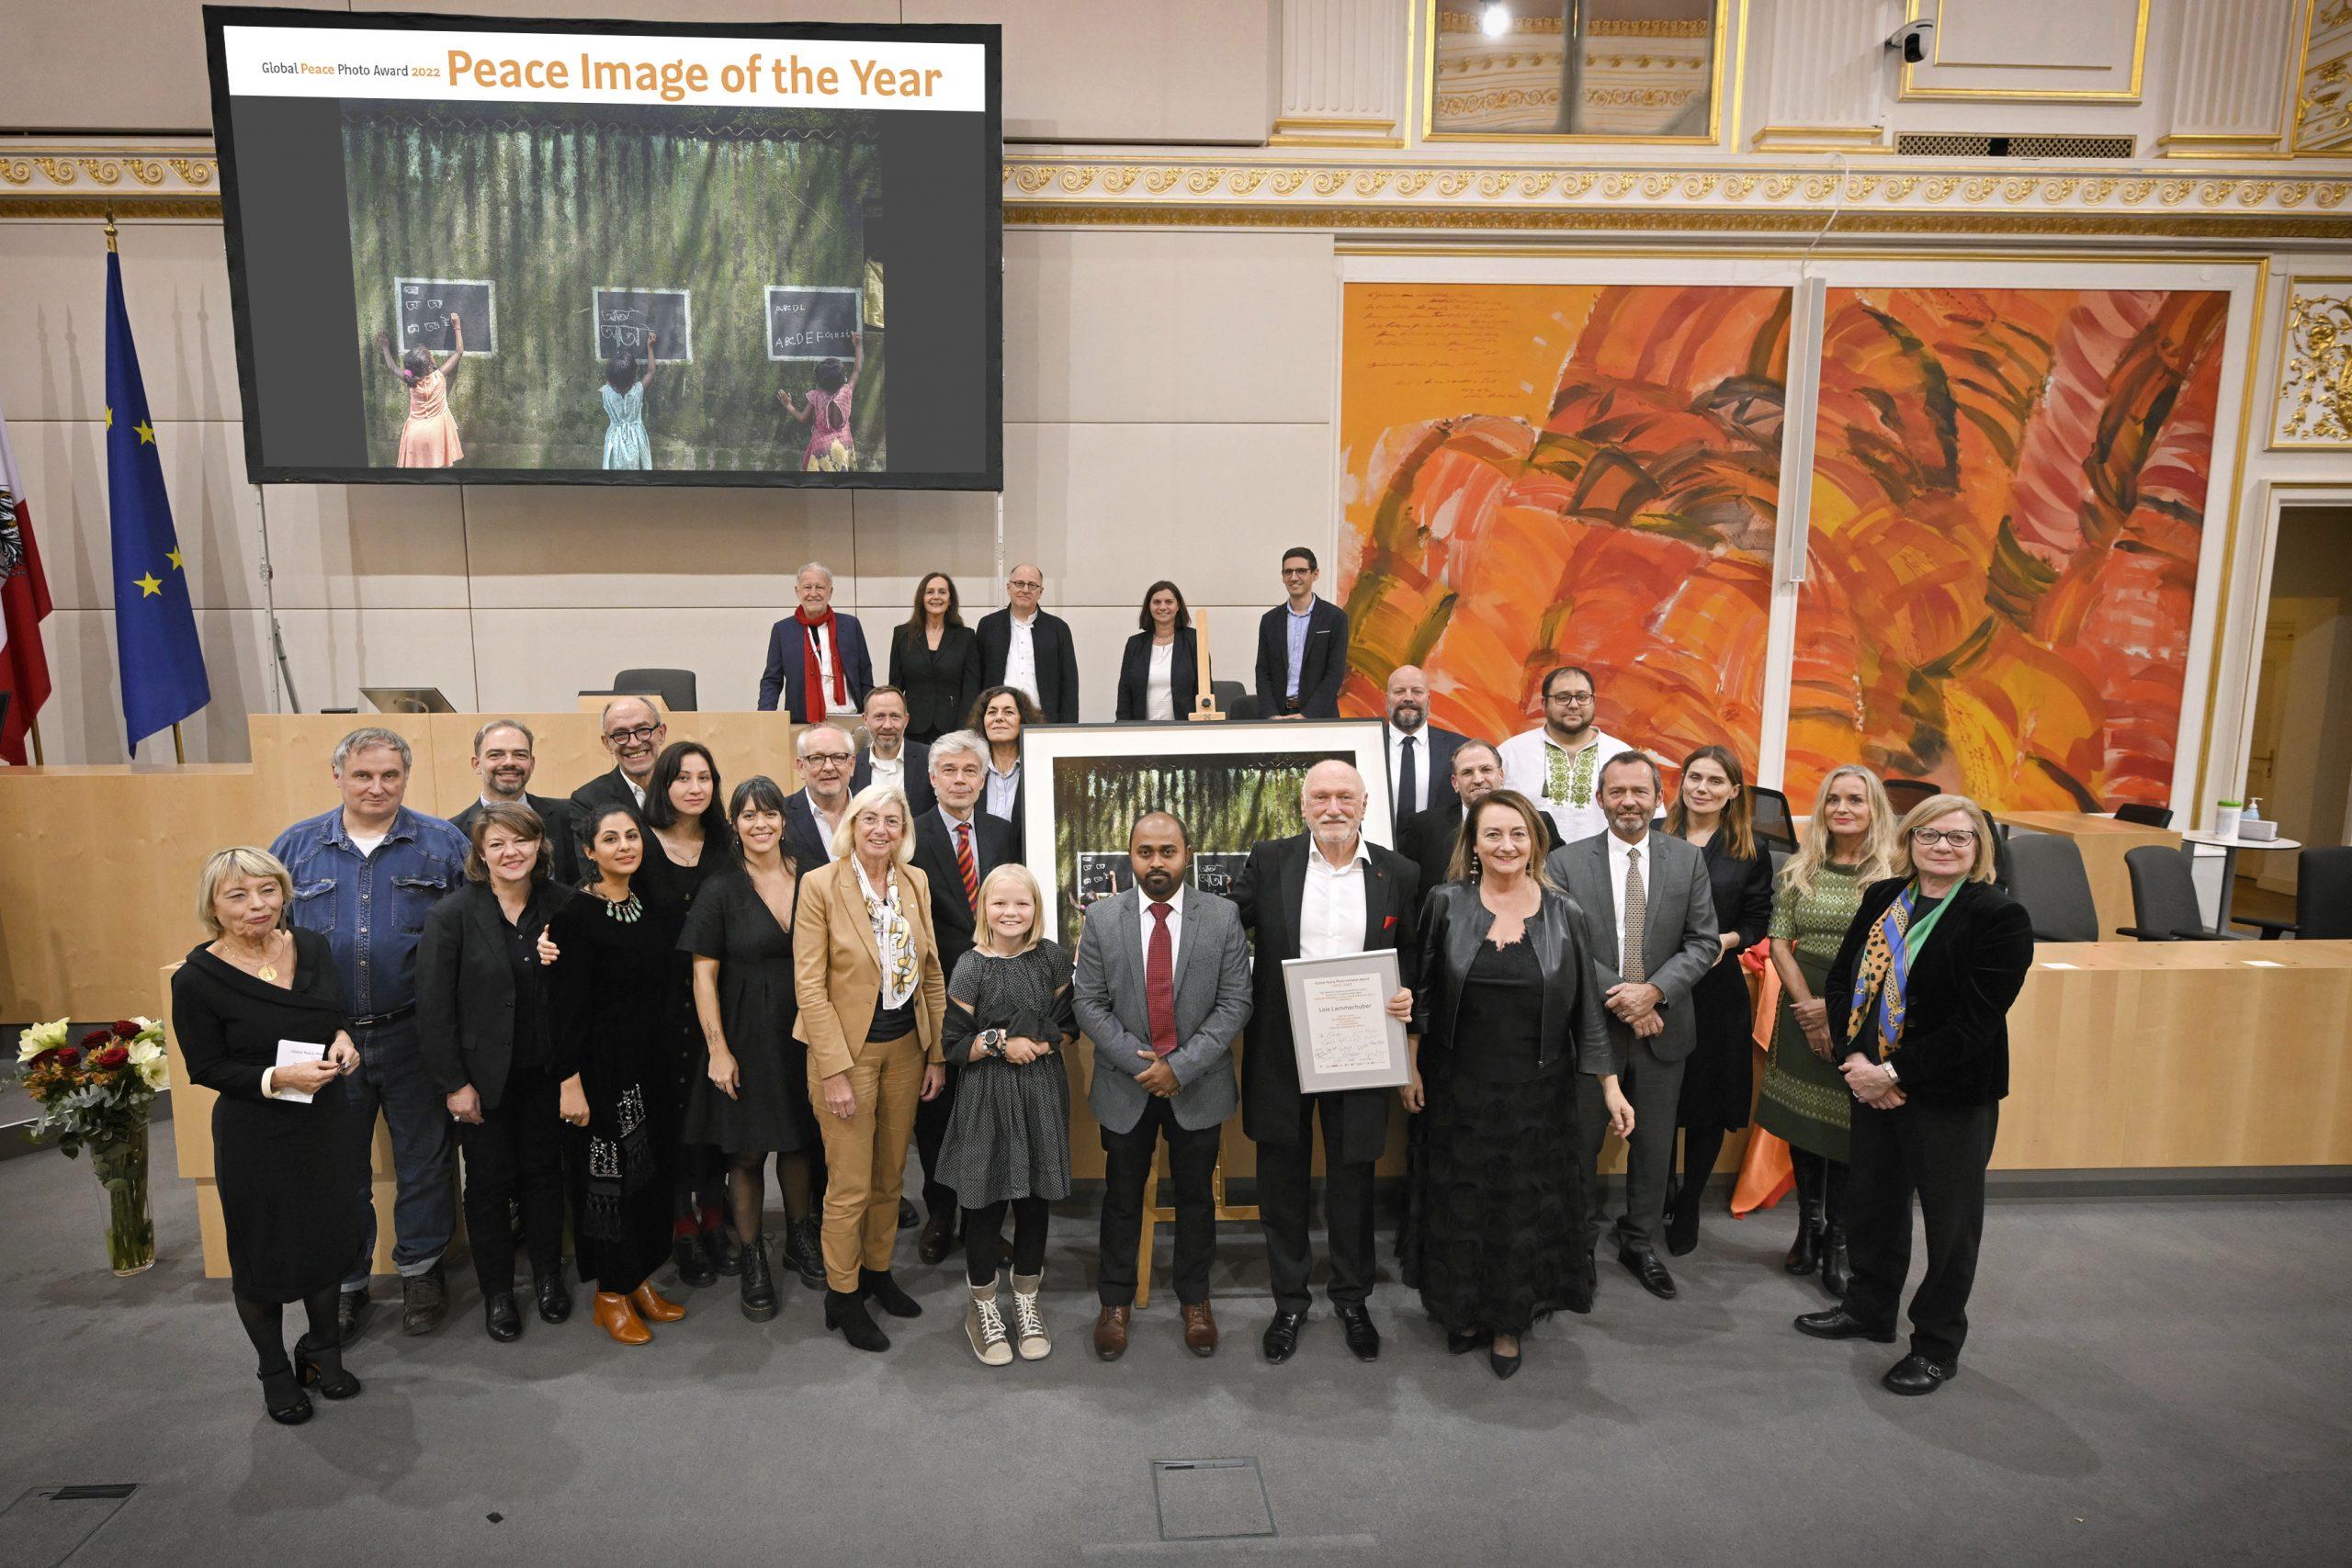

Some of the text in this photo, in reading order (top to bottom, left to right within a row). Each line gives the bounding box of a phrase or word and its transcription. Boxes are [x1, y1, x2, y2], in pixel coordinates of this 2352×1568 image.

[262, 62, 441, 77] Global Peace Photo Award 2022
[447, 50, 943, 100] Peace Image of the Year
